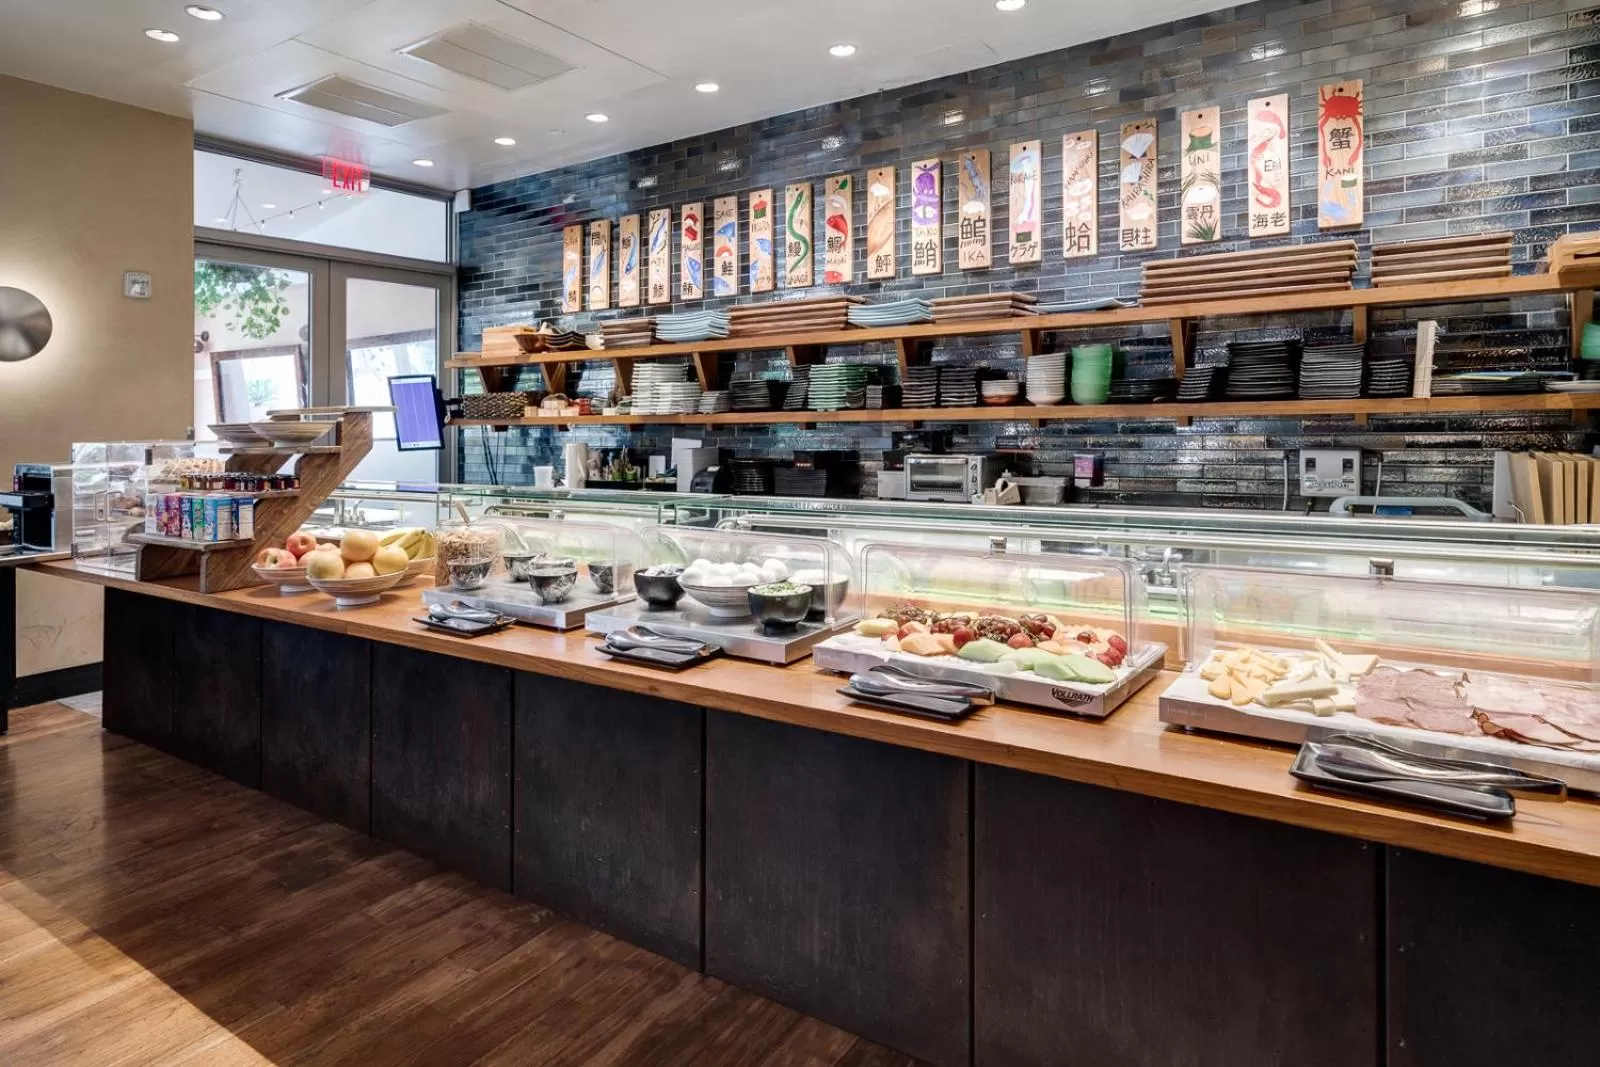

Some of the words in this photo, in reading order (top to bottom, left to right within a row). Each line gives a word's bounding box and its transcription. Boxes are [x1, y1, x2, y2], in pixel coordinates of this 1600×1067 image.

[1329, 127, 1354, 151] 蟹
[332, 161, 362, 191] EXIT
[1252, 212, 1287, 230] 海老
[1065, 222, 1091, 252] 蛤
[1121, 227, 1153, 248] 貝柱
[963, 250, 985, 262] IKA
[1010, 241, 1038, 258] クラゲ
[721, 261, 734, 276] 鮭
[1052, 687, 1094, 703] VOLLRATH
